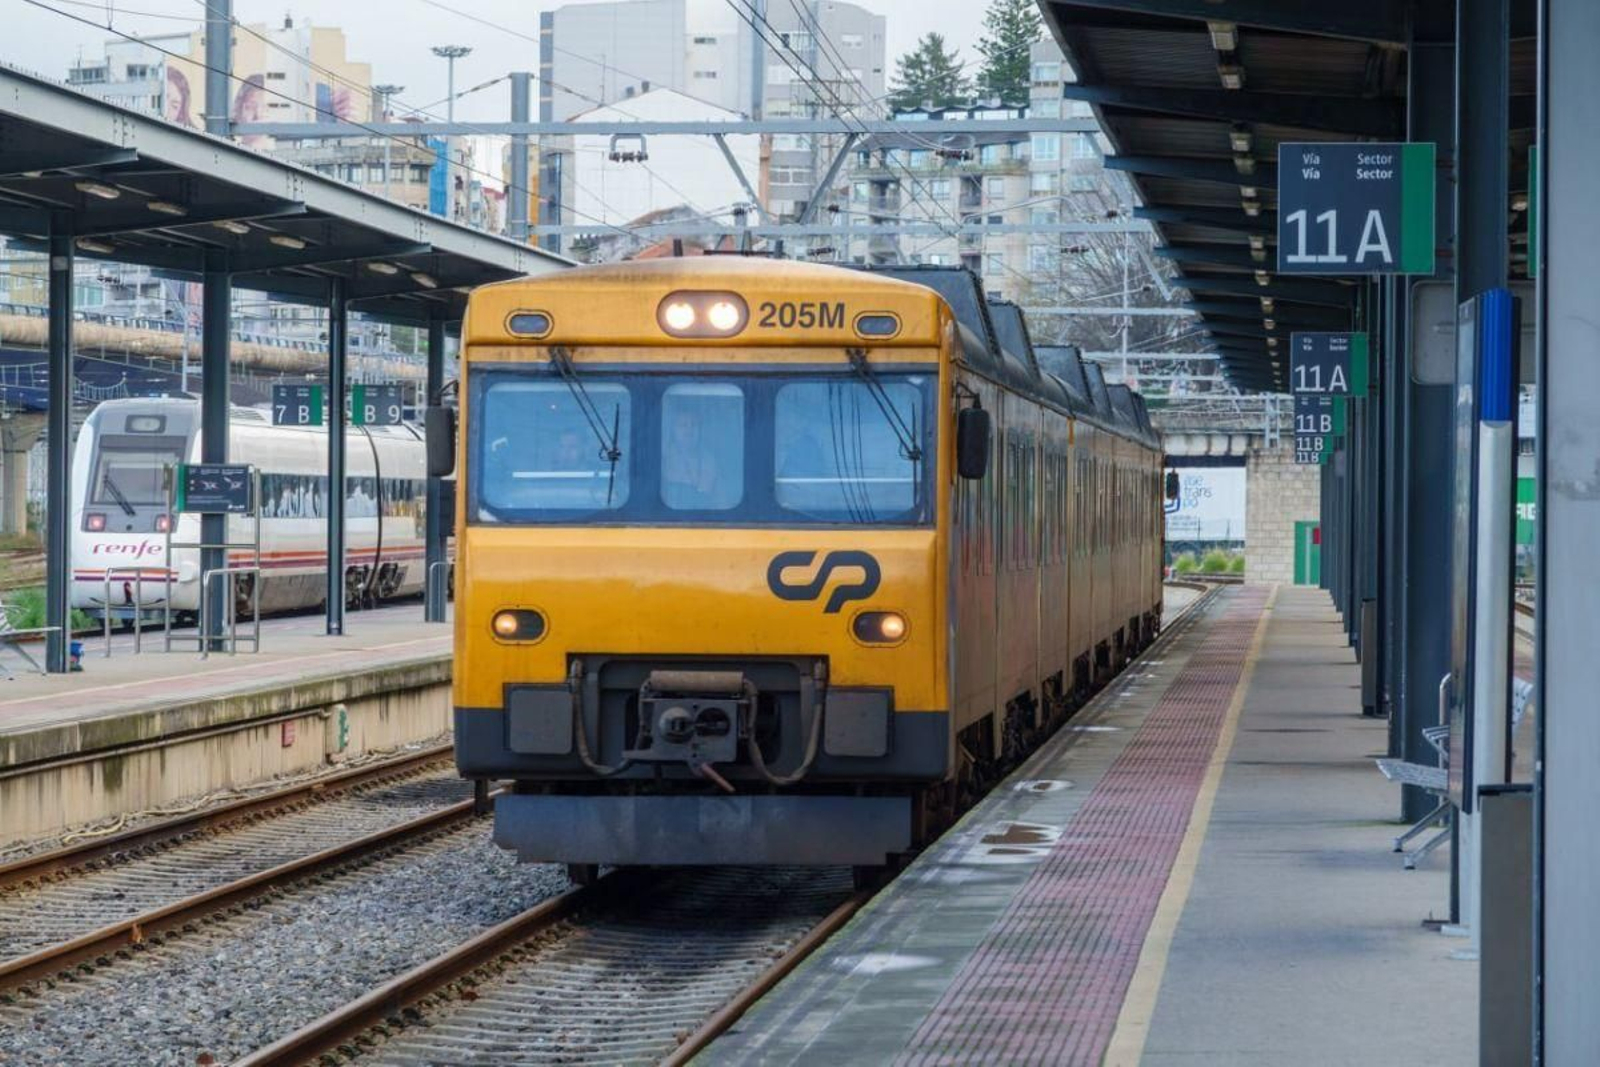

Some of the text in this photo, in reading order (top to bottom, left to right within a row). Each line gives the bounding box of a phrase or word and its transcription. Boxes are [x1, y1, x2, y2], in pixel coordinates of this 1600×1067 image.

[1302, 152, 1393, 165] Vía Sector
[1301, 167, 1393, 180] Vía Sector
[1286, 209, 1393, 263] 11 A
[758, 302, 845, 329] 205M
[1295, 364, 1348, 392] 11 A
[276, 405, 310, 423] 7 B
[364, 405, 400, 423] B 9
[1296, 414, 1332, 432] 11 B
[1296, 437, 1324, 451] 11 B
[93, 540, 162, 559] renfe
[766, 550, 881, 614] CP
